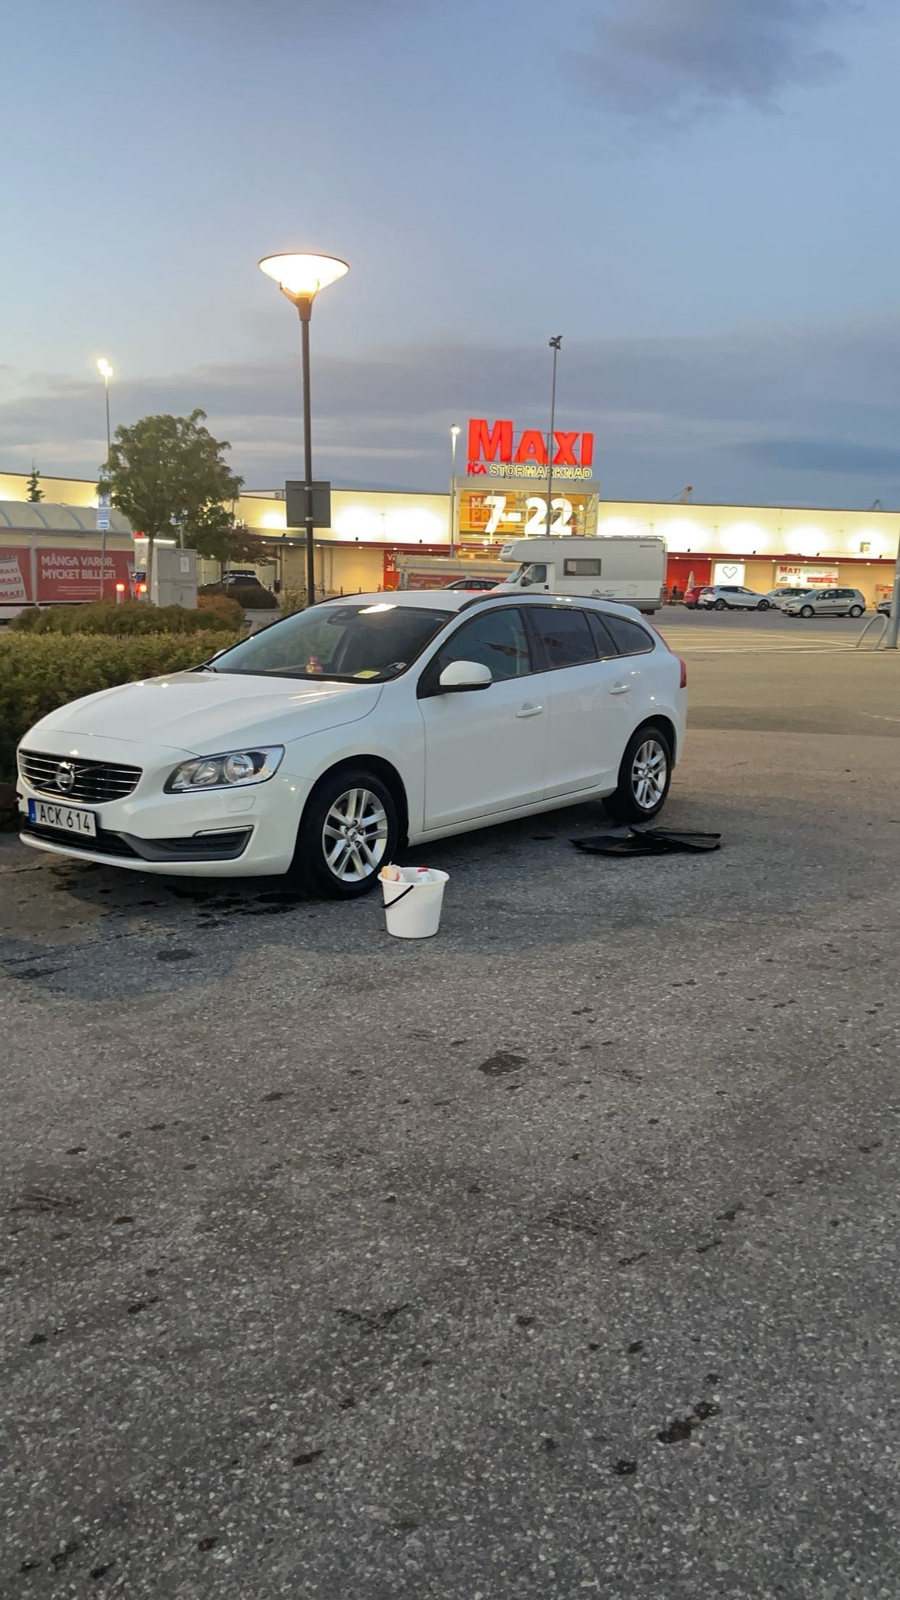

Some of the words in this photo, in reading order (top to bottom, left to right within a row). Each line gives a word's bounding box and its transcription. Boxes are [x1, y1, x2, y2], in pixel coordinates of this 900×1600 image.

[467, 418, 594, 466] MAXI
[466, 462, 487, 475] ICA
[489, 464, 593, 479] STORMARKNAD
[484, 495, 573, 536] 7-22
[41, 553, 79, 566] MÅNGA
[42, 569, 80, 579] MYCKET
[40, 804, 63, 826] ACK
[66, 811, 90, 832] 614
